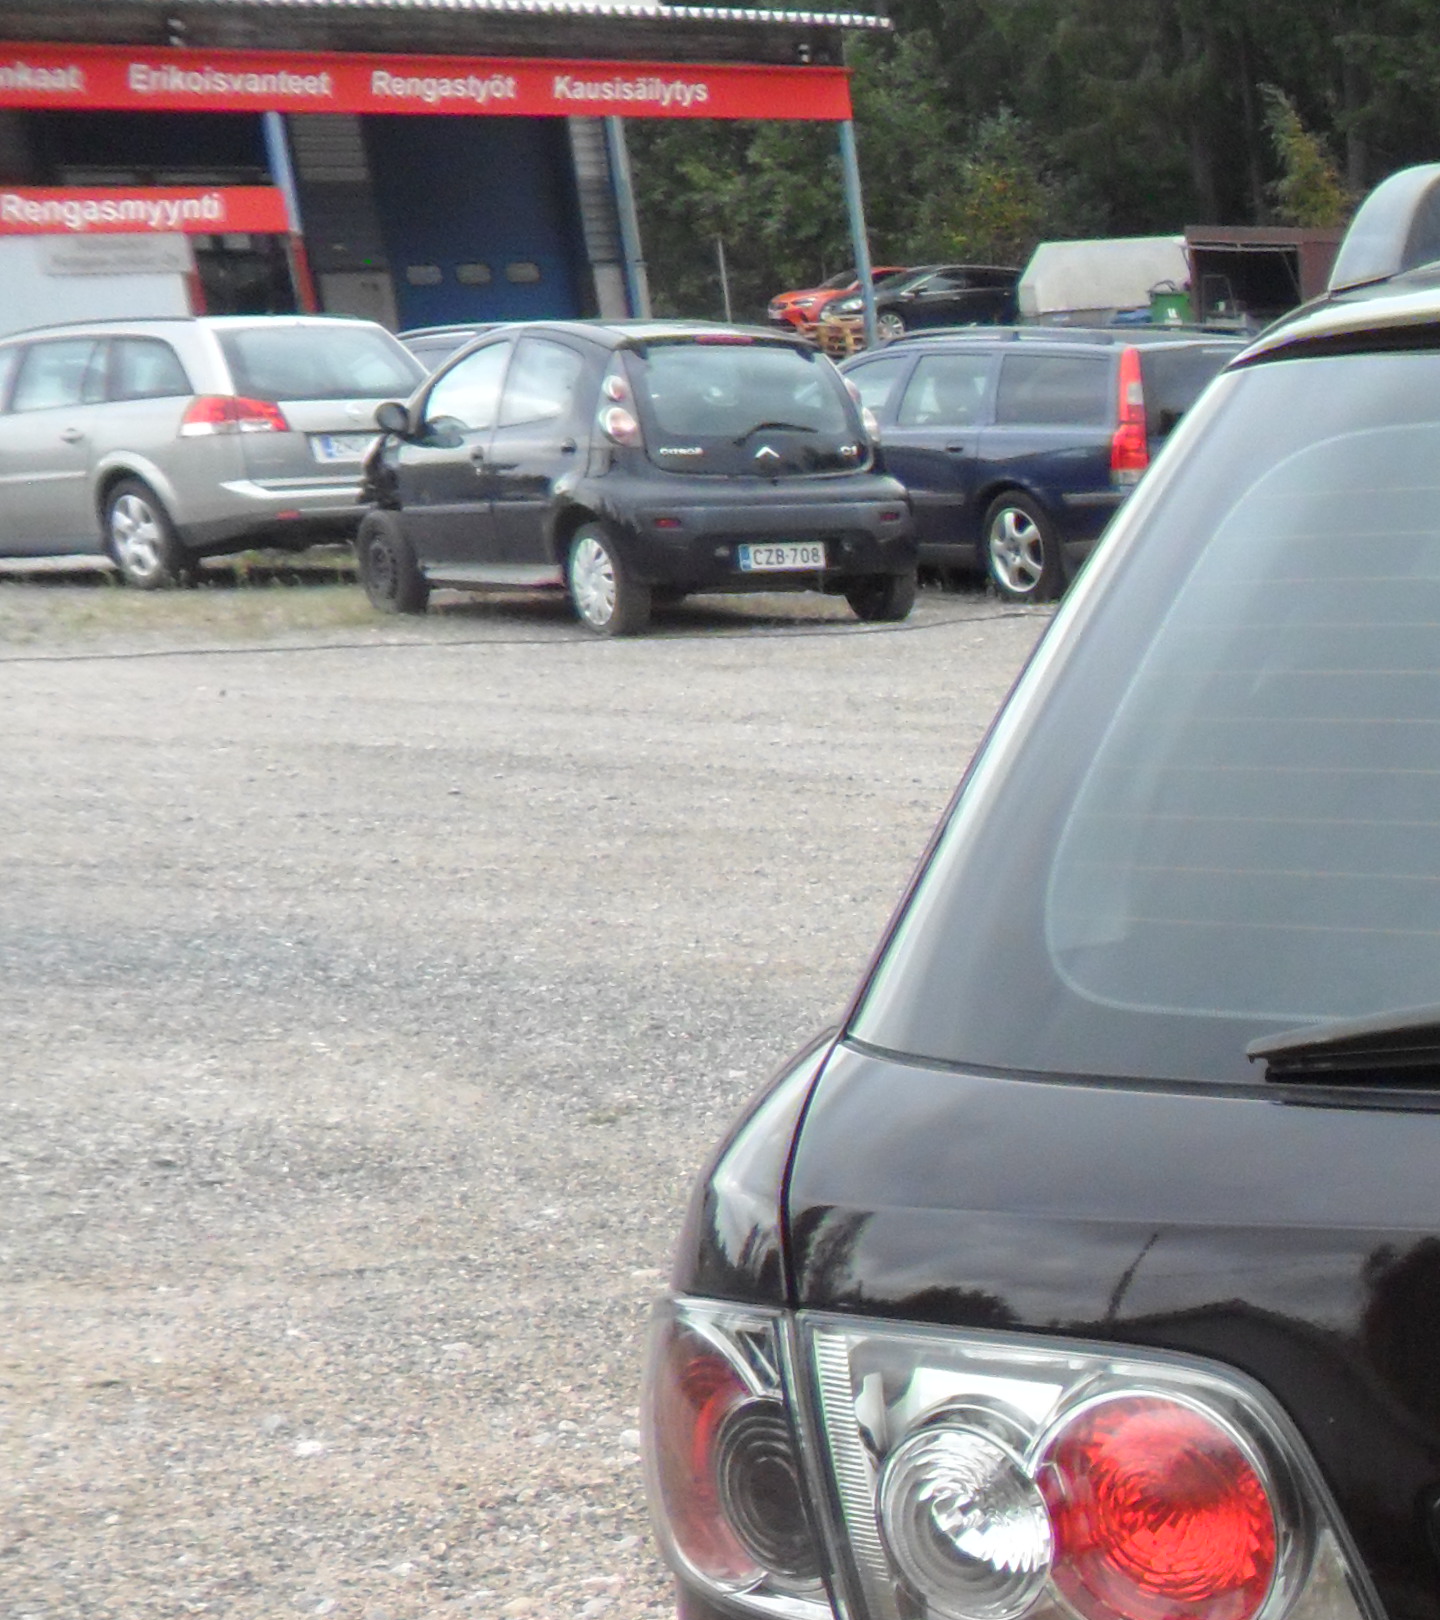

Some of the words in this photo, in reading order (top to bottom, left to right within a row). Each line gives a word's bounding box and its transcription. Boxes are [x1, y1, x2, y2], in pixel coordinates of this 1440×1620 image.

[129, 63, 332, 97] Erikoisvanteet
[371, 70, 516, 102] Rengastyöt
[554, 75, 709, 106] Kausisäilytys
[1, 194, 226, 230] Rengasmyynti
[753, 547, 821, 565] CZB-708
